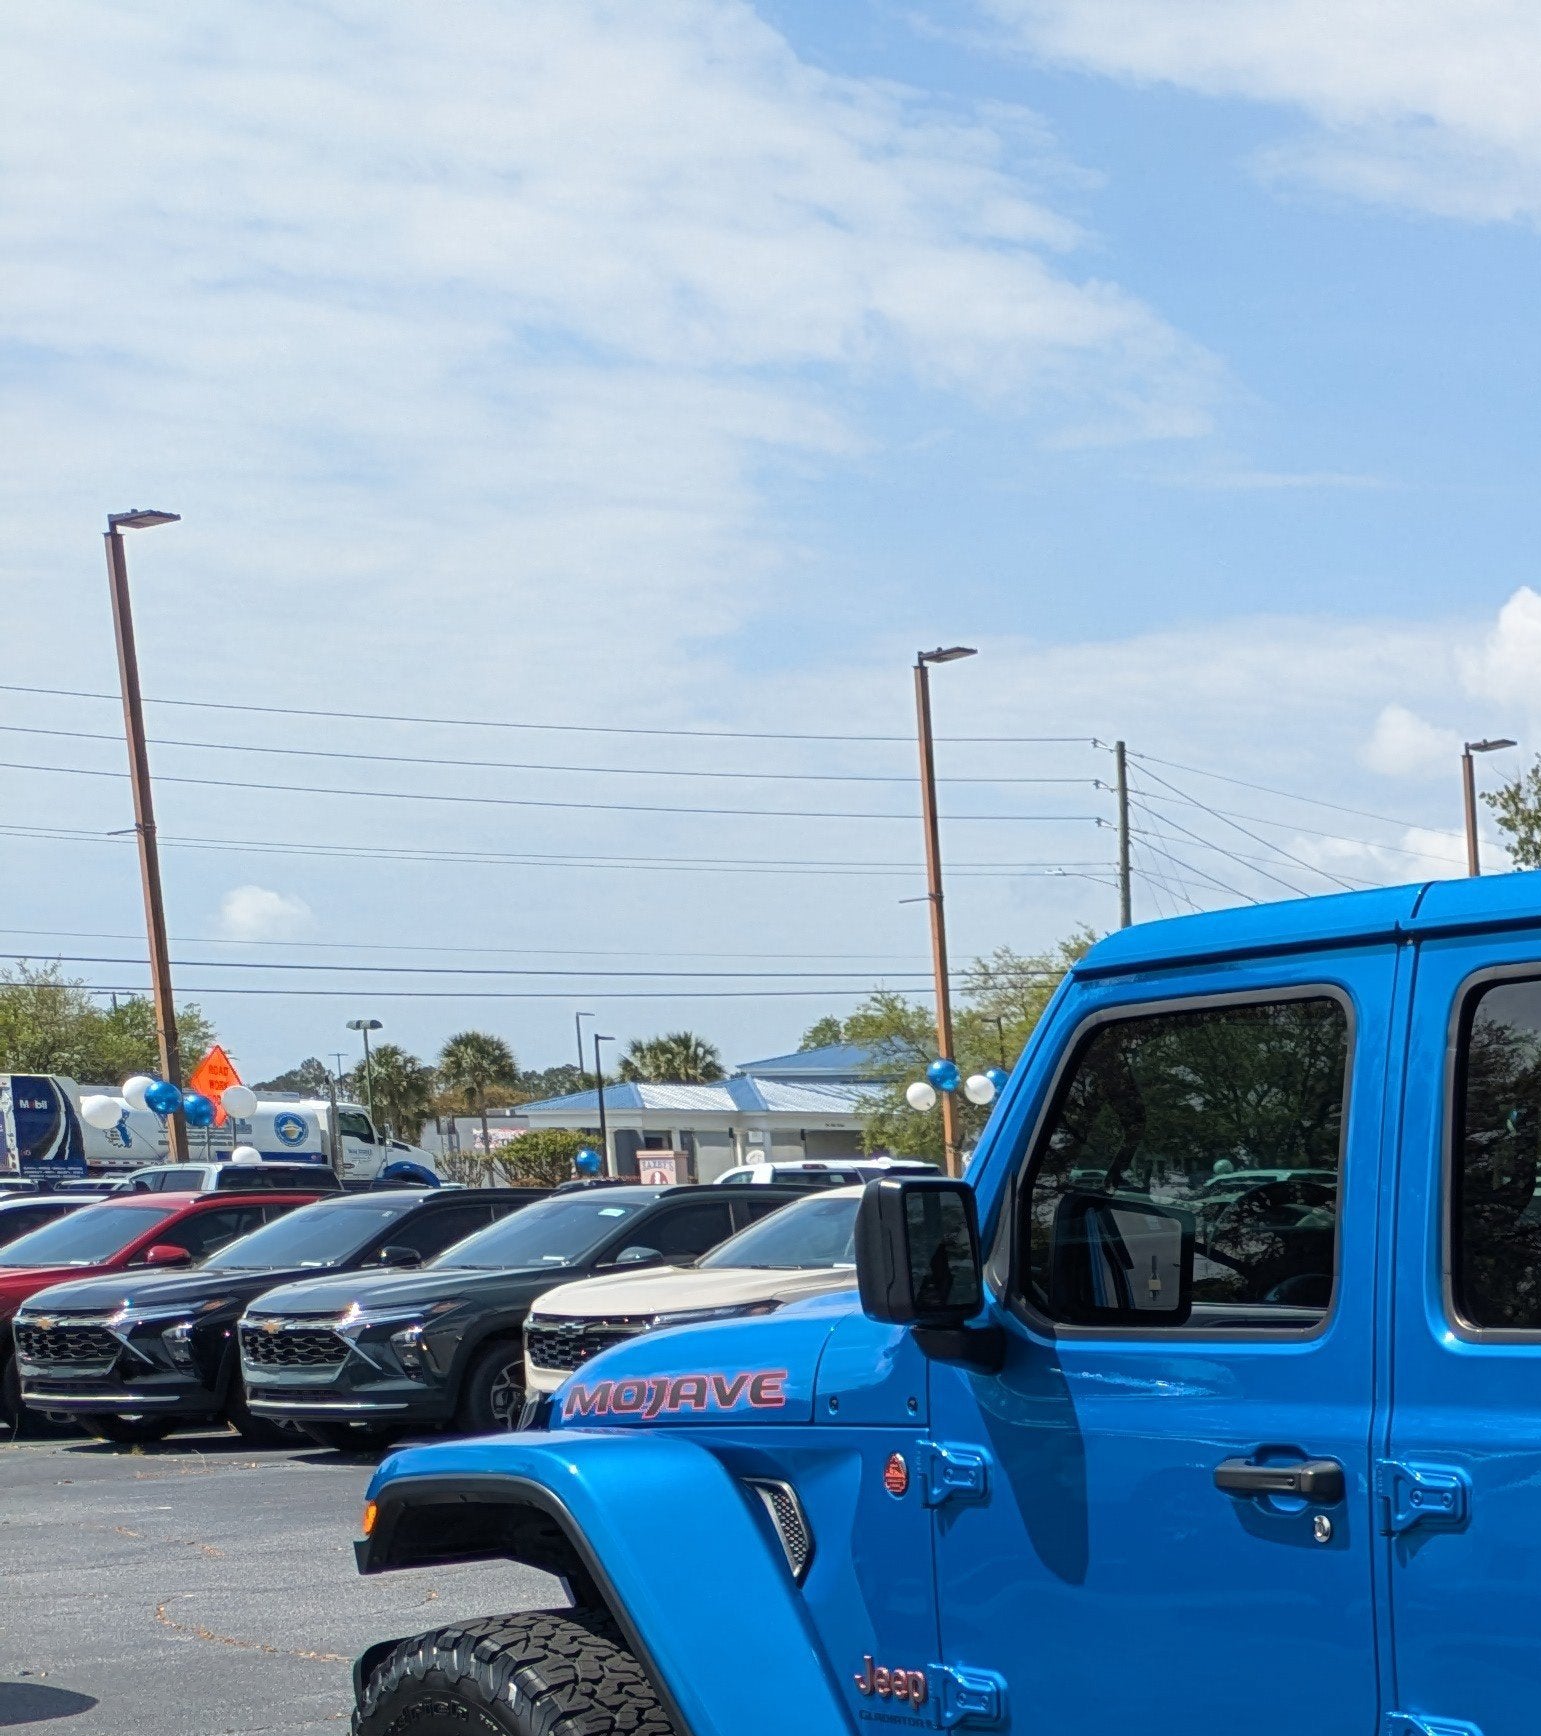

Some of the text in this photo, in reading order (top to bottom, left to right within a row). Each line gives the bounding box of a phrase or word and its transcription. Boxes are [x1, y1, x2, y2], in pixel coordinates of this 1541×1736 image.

[20, 1100, 48, 1110] Mobil
[563, 1370, 788, 1420] MOJAVE
[853, 1655, 928, 1712] Jeep
